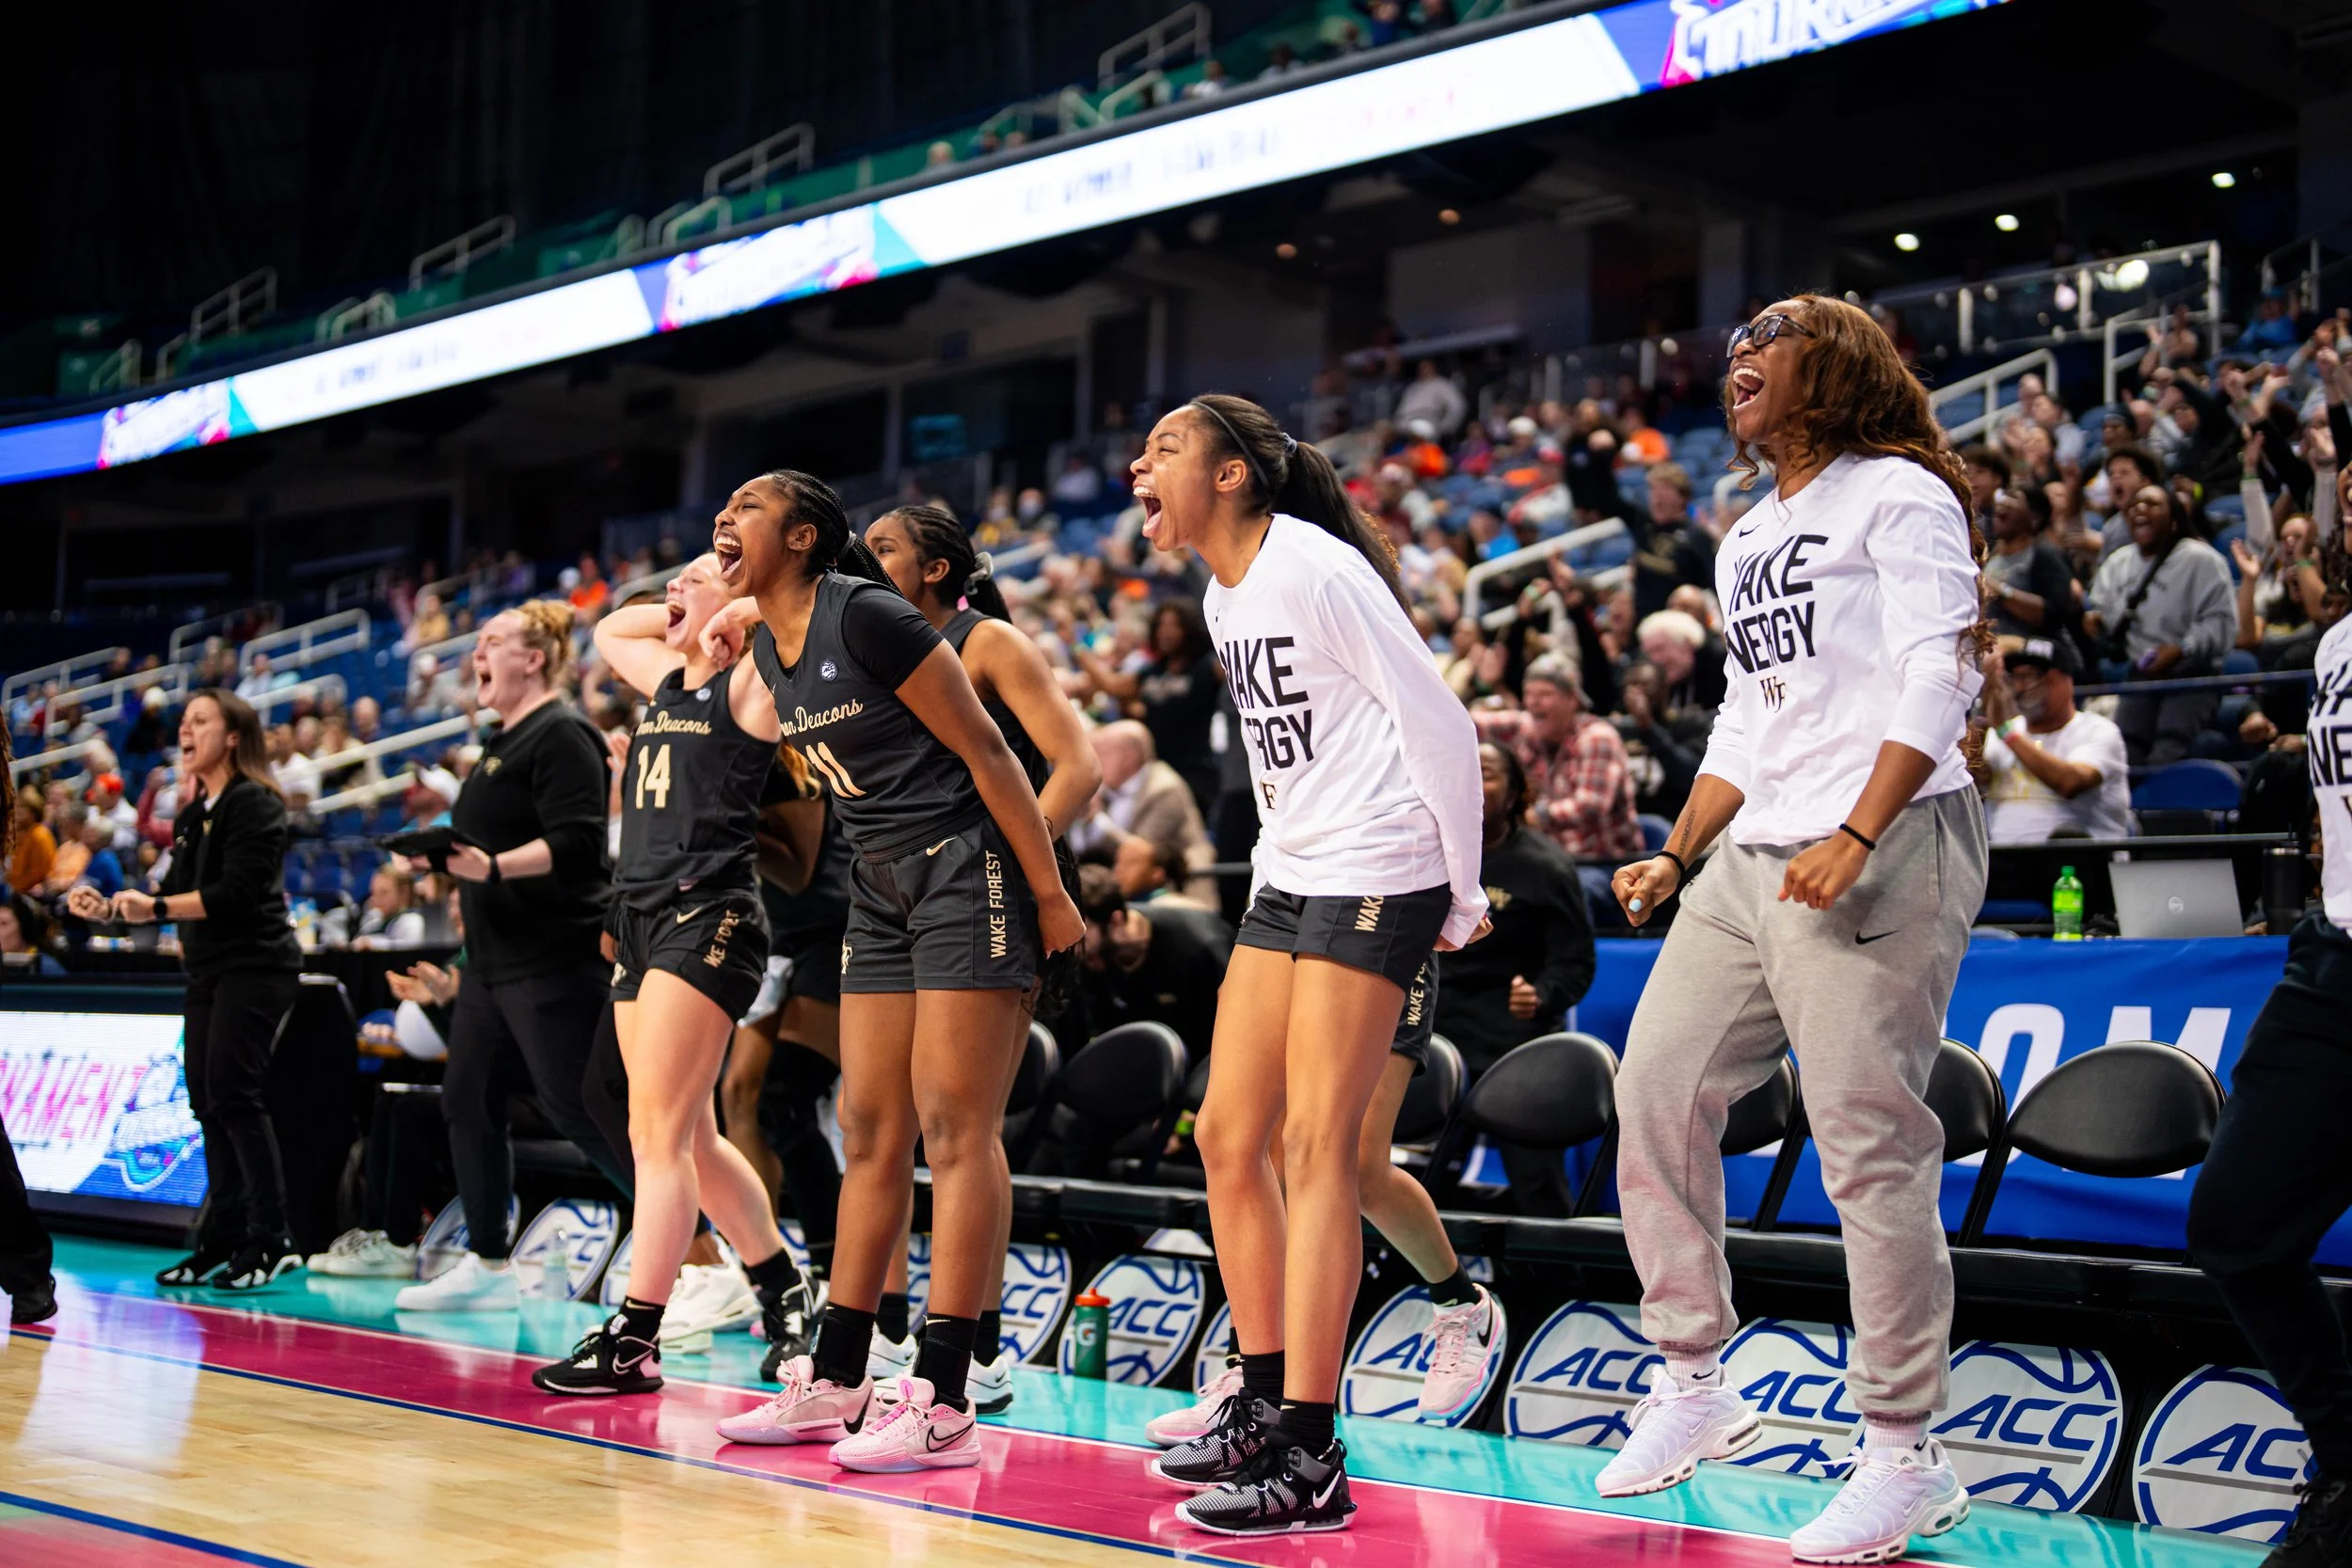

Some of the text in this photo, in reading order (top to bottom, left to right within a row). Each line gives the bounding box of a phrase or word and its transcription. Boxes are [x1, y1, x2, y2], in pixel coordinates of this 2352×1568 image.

[1725, 600, 1816, 675] NERGY
[655, 710, 712, 736] Deacons
[795, 699, 864, 733] Deacons
[635, 744, 671, 809] 14
[805, 741, 867, 799] 11
[985, 849, 1007, 958] WAKE FOREST
[1406, 987, 1424, 1026] WAKE
[1001, 1282, 1063, 1320] CC
[1076, 1322, 1097, 1346] G
[1930, 1393, 2117, 1451] ACC
[2162, 1422, 2320, 1481] AC
